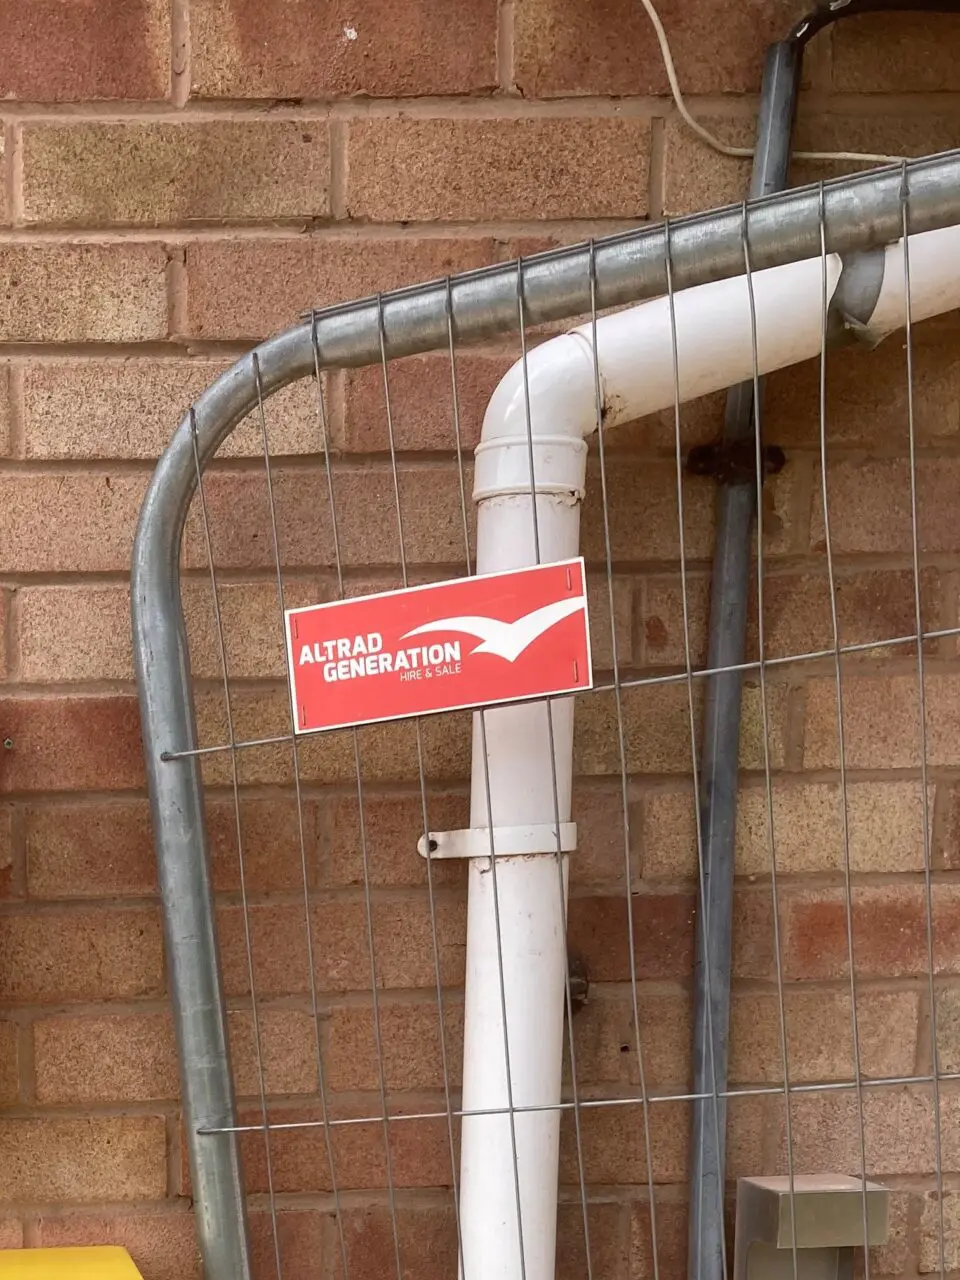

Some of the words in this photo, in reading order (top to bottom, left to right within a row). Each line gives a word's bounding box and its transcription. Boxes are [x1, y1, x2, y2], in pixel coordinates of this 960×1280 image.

[299, 632, 382, 665] ALTRAD
[323, 641, 461, 682] GENERATION
[400, 668, 422, 682] HIRE
[425, 668, 432, 678] &
[435, 664, 461, 676] SALE
